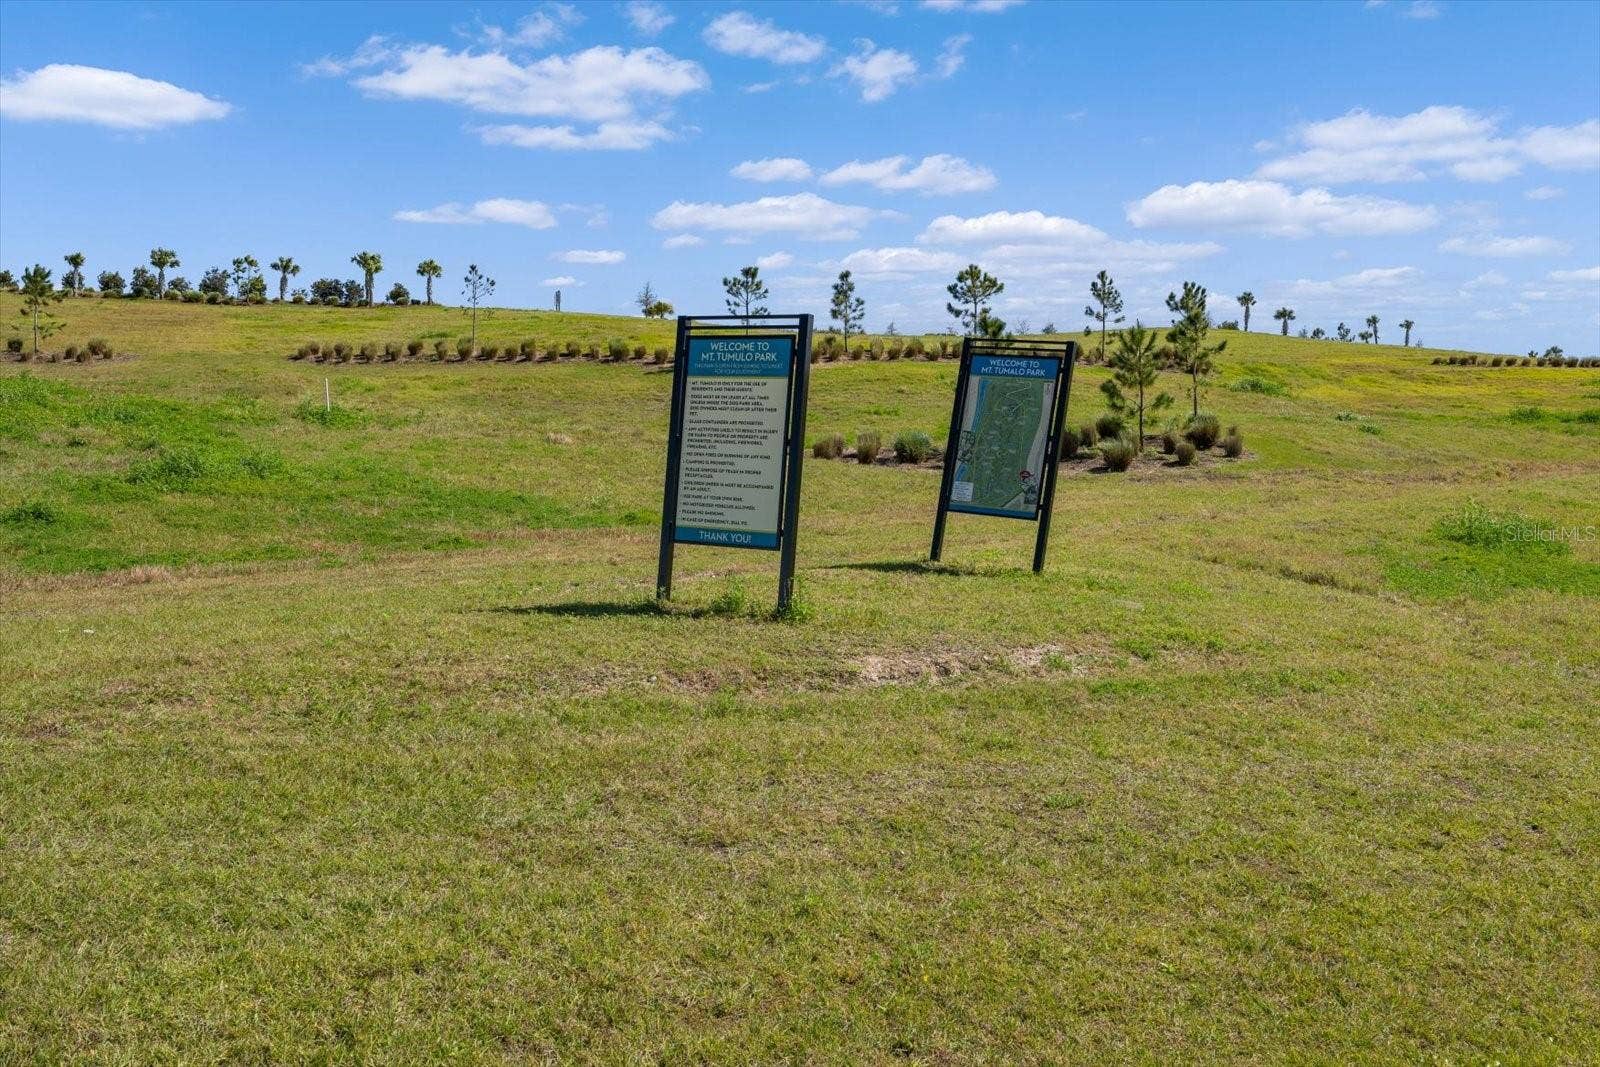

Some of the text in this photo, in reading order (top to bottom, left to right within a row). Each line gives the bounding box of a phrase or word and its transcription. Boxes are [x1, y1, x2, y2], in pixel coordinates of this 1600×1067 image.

[710, 341, 769, 351] WELCOME TO
[701, 352, 777, 362] MT. TUMULO PARK
[989, 359, 1040, 368] WELCOME TO
[995, 366, 1025, 376] TUMALO
[1026, 368, 1046, 376] PARK
[699, 531, 752, 543] THANK YOU!
